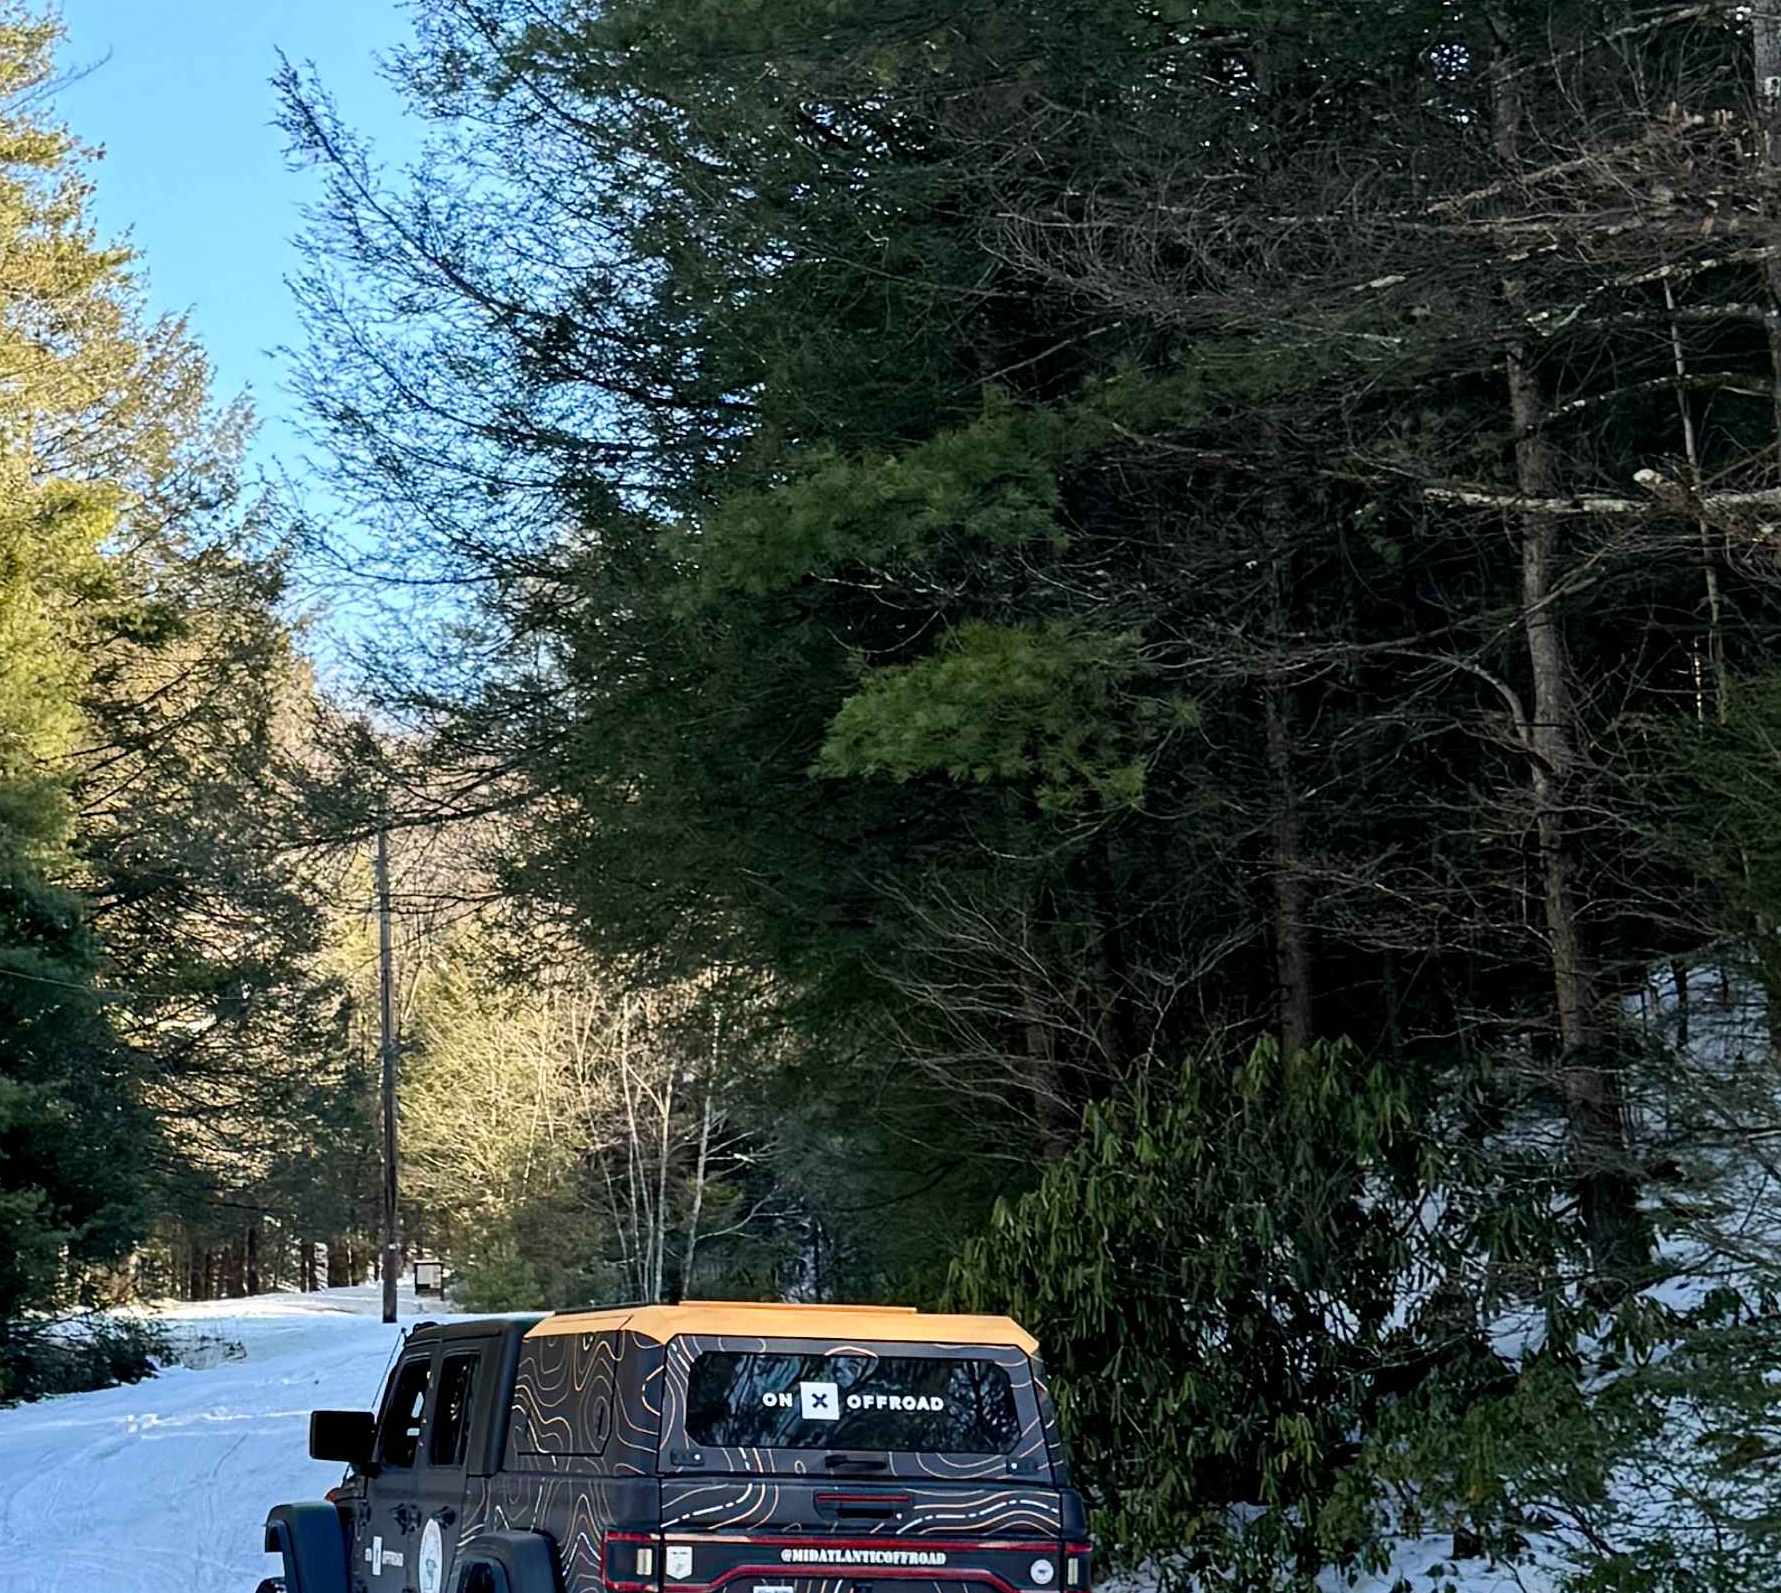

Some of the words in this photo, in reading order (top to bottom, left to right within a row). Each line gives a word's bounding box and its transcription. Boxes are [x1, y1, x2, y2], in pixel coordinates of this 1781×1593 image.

[762, 1392, 793, 1408] ON
[846, 1394, 944, 1411] OFFROAD
[780, 1549, 946, 1565] @MIDATLANTICOFFROAD
